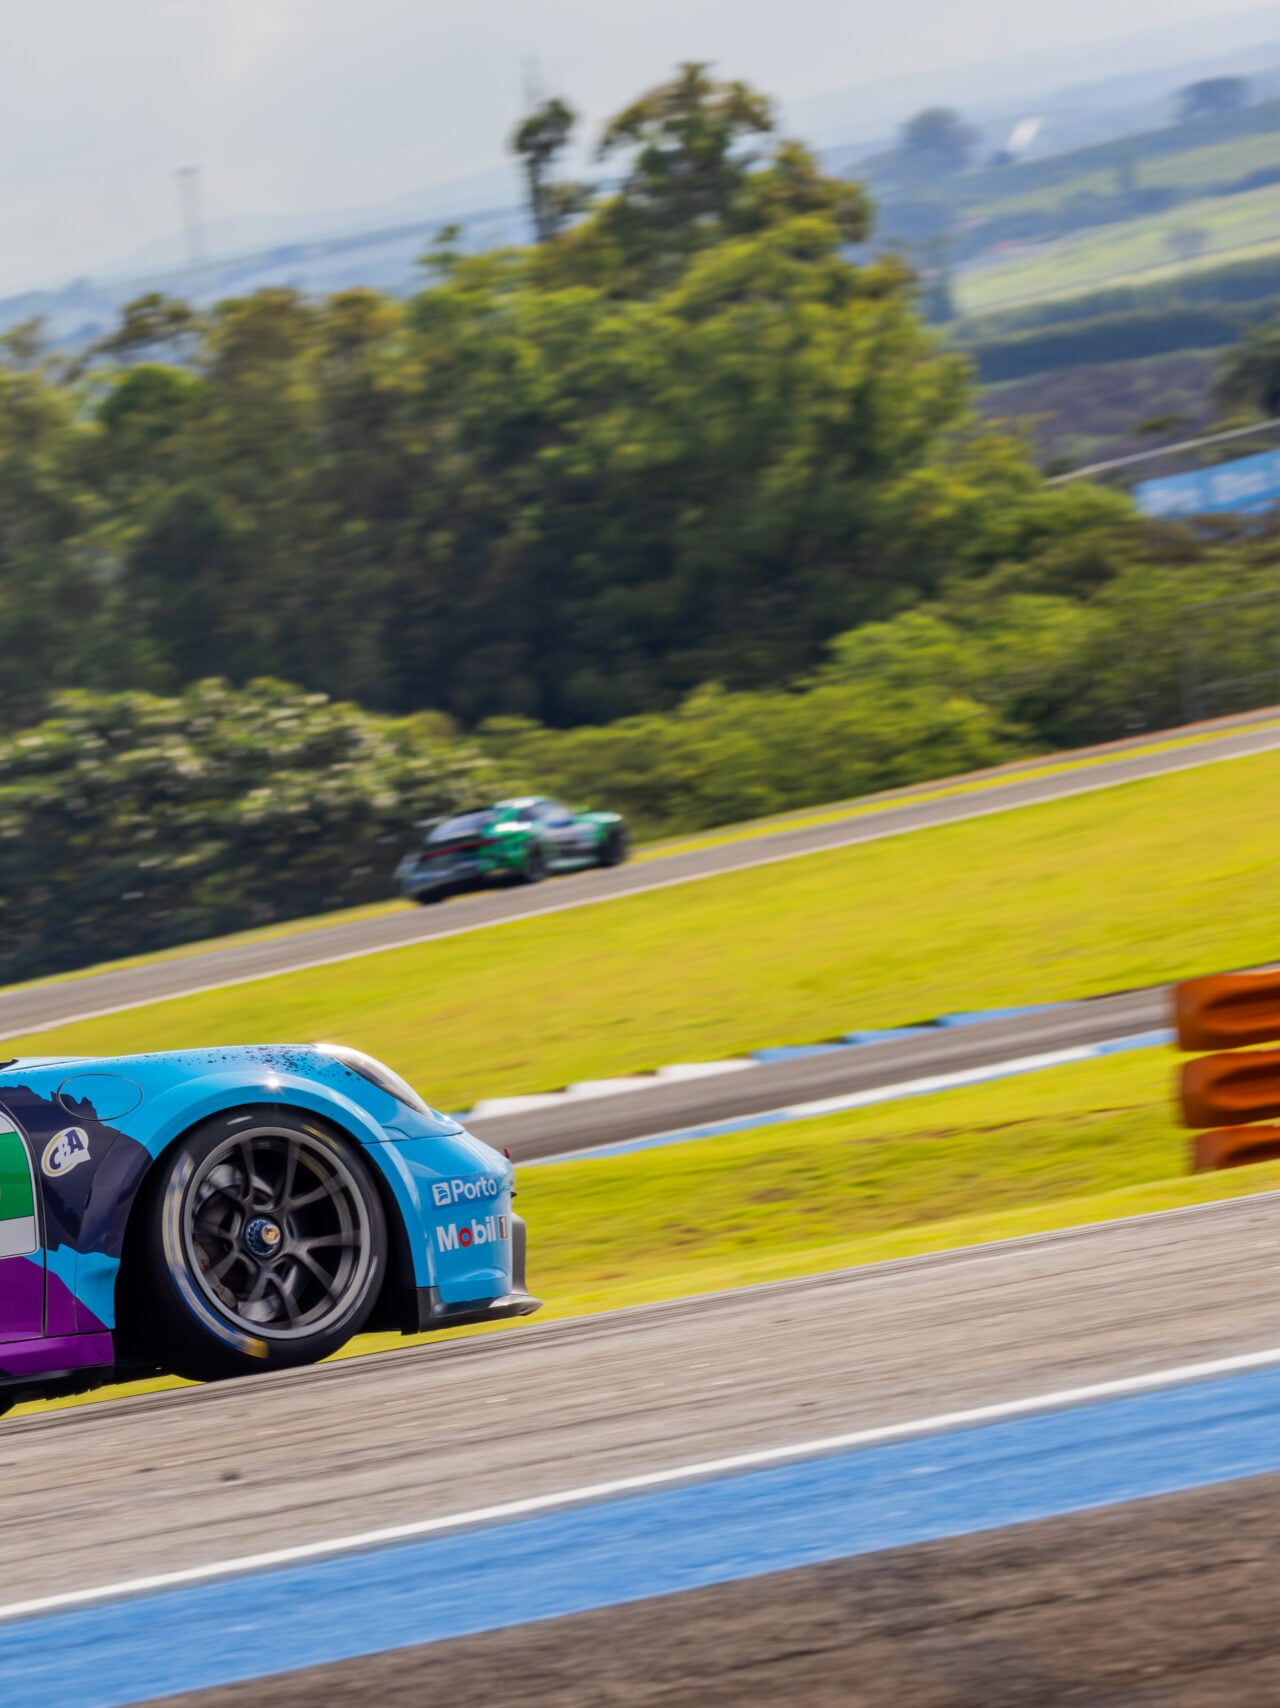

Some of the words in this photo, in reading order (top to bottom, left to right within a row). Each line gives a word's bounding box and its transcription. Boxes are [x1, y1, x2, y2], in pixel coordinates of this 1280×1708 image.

[49, 1129, 86, 1171] CBA
[450, 1176, 497, 1202] Porto
[435, 1215, 497, 1253] Mobil
